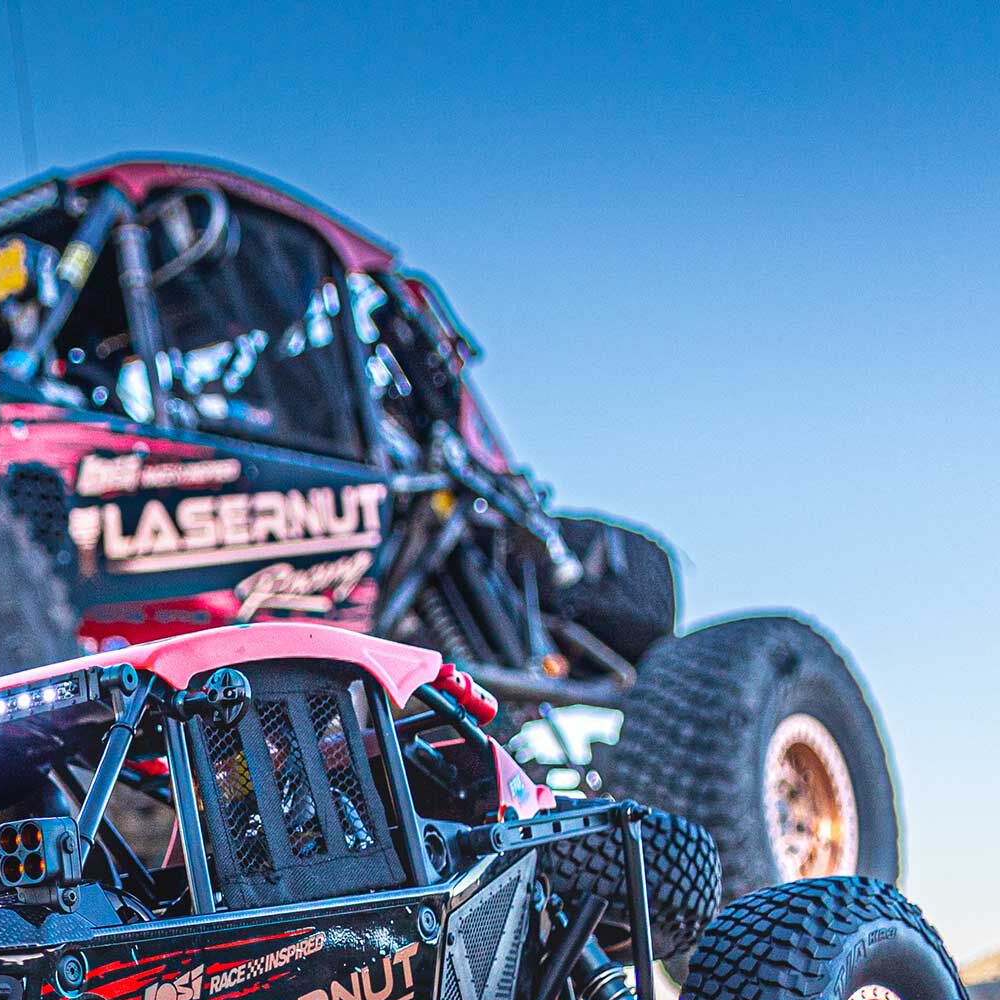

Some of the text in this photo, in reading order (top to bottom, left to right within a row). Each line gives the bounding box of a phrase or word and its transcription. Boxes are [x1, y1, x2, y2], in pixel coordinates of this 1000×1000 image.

[104, 484, 387, 560] LASERNUT
[209, 963, 247, 995] RACE
[263, 933, 326, 974] INSPIRED
